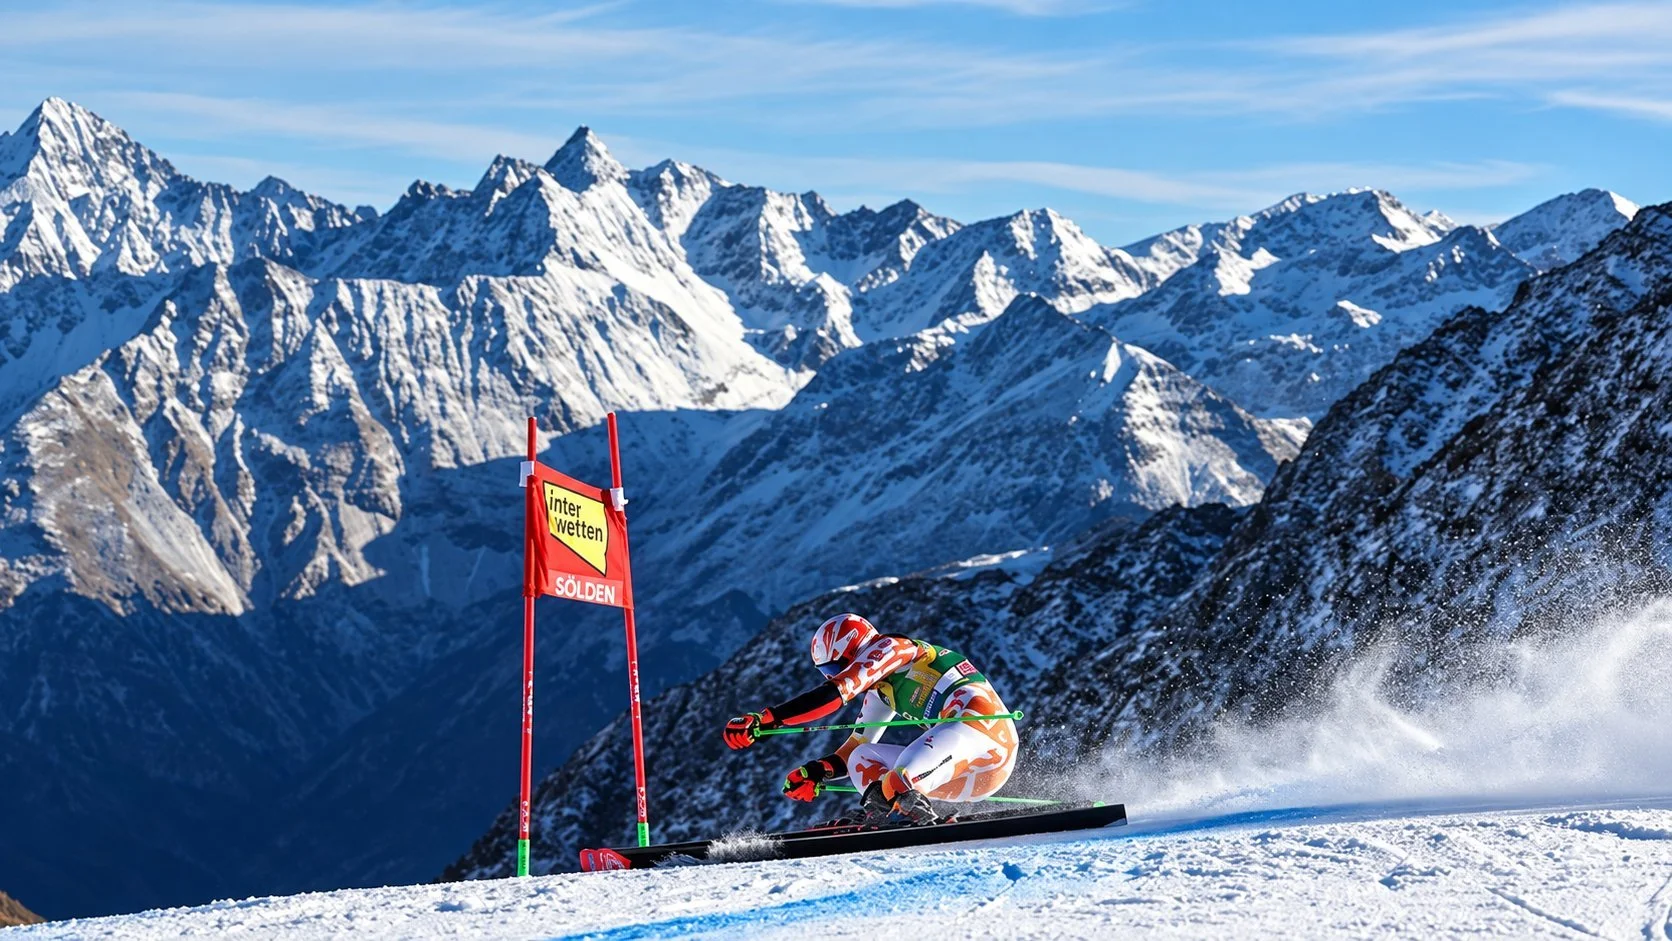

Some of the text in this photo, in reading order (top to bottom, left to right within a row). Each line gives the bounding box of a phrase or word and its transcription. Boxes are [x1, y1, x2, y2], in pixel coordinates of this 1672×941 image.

[550, 489, 581, 518] inter
[555, 517, 603, 542] wetten
[555, 575, 615, 604] SÖLDEN
